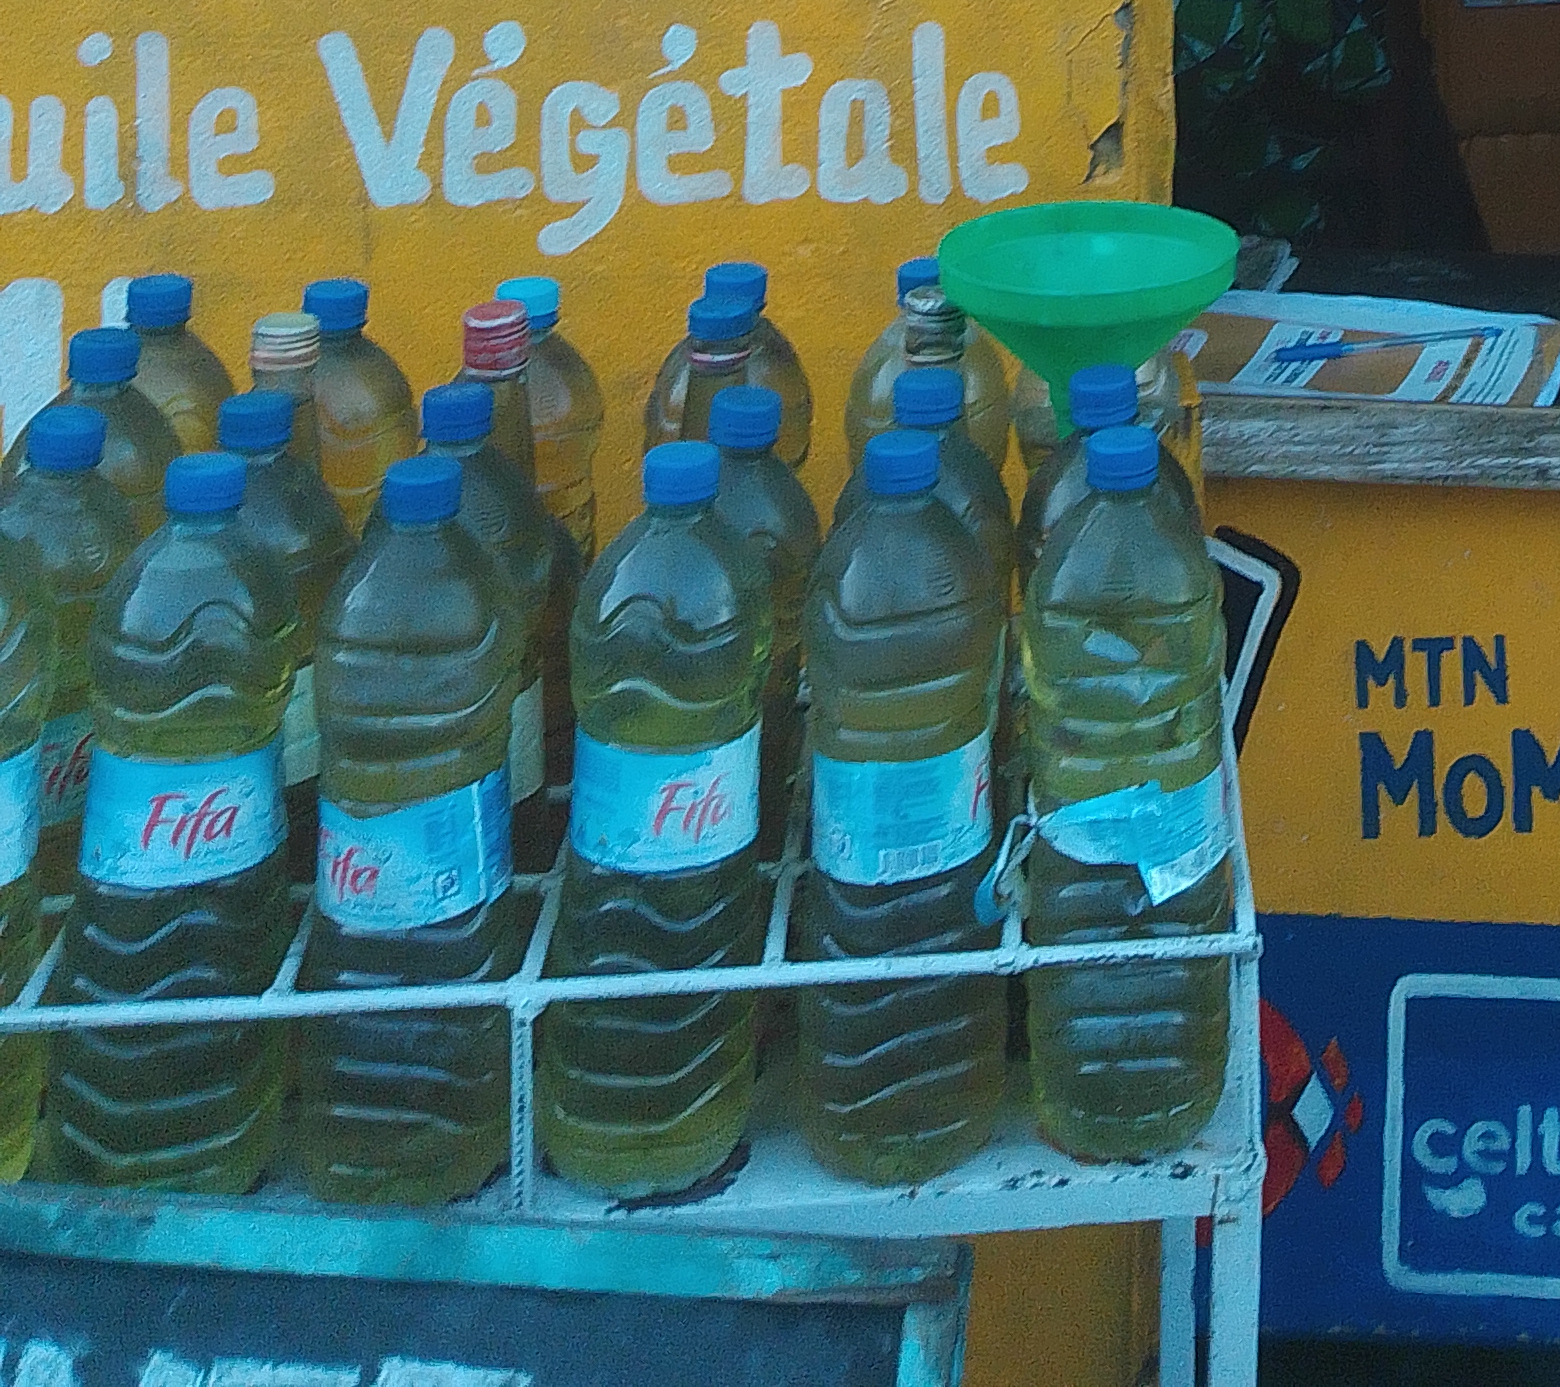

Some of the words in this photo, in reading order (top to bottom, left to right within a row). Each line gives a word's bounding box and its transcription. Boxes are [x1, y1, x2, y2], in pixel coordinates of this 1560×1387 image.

[317, 20, 1029, 256] Végétale
[1354, 633, 1510, 710] MTN
[141, 786, 241, 860] Fifa
